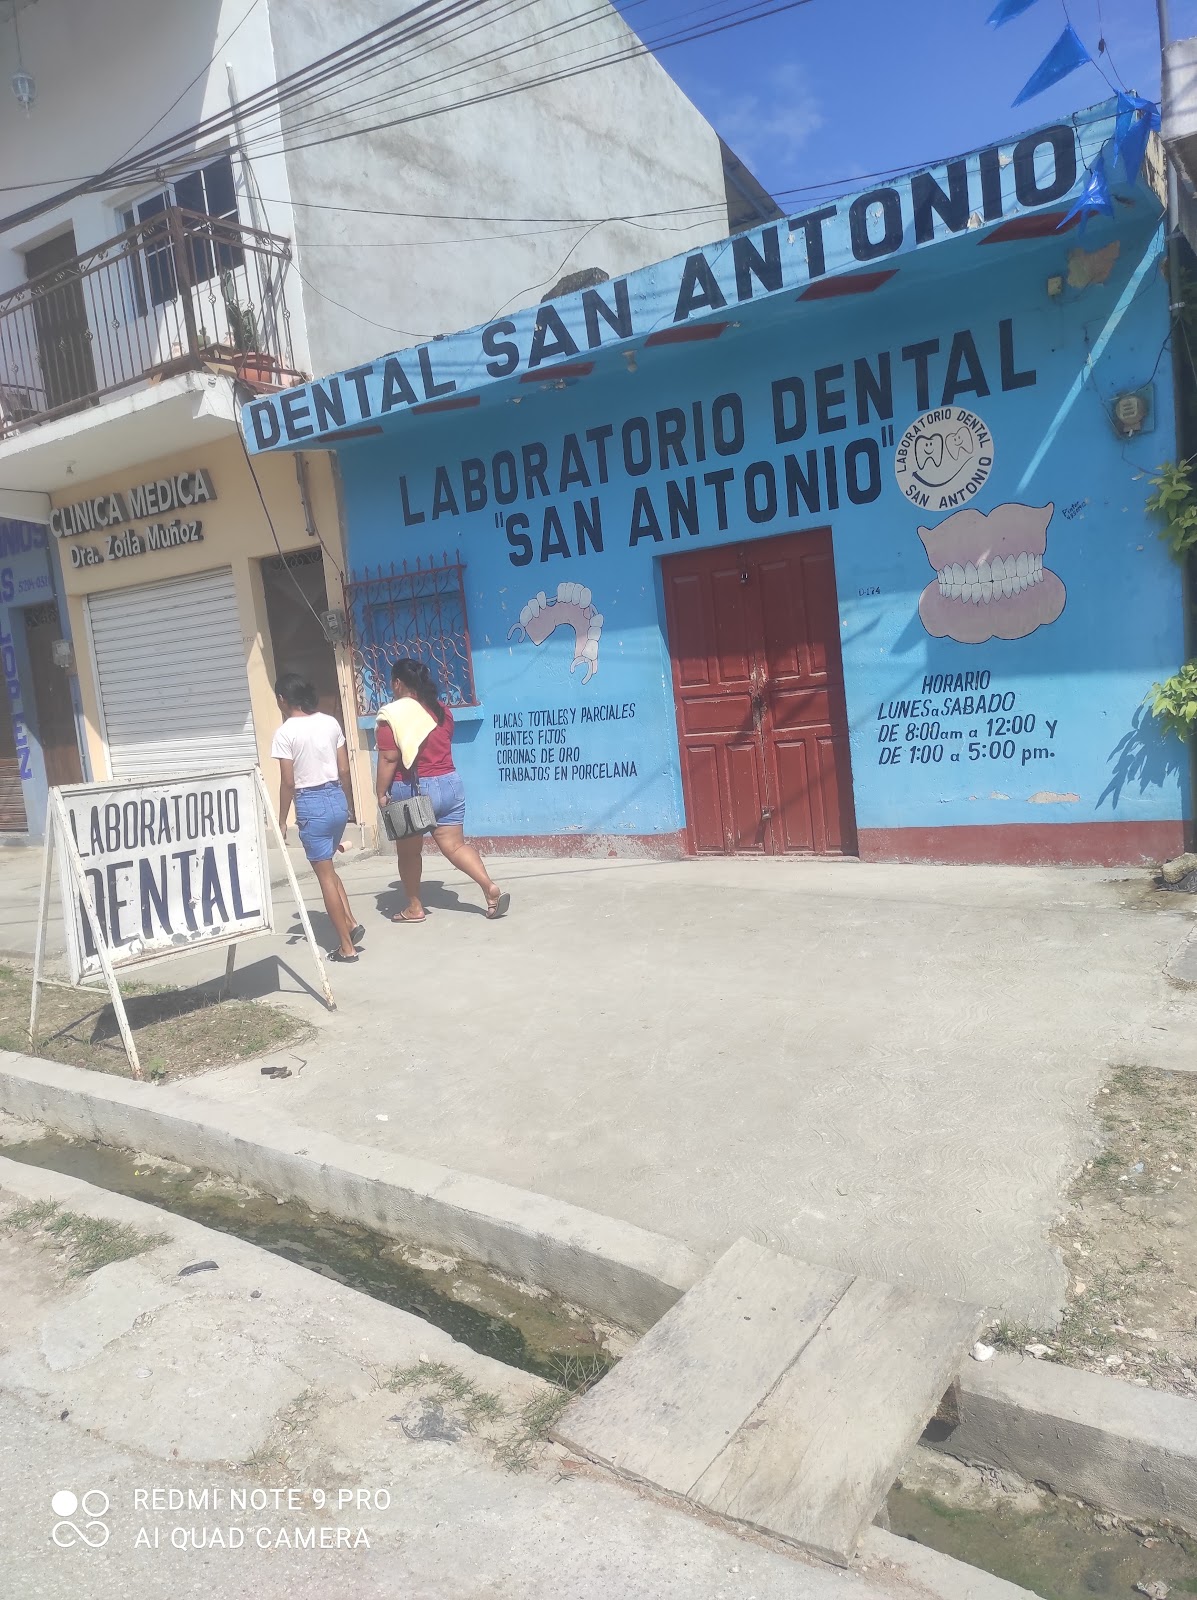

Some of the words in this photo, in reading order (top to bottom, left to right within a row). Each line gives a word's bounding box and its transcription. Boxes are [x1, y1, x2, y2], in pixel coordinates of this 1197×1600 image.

[249, 347, 456, 450] DENTAL
[482, 280, 633, 377] SAN
[673, 124, 1077, 322] ANTONIO
[400, 392, 745, 527] LABORATORIO
[771, 318, 1037, 444] DENTAL
[897, 408, 952, 474] LABORATORIO
[956, 410, 990, 448] DENTAL
[906, 484, 930, 507] SAN
[939, 456, 992, 509] ANTONIO
[50, 492, 126, 538] CLINICA
[128, 469, 213, 520] MEDICA
[70, 545, 101, 569] Dra.
[105, 529, 143, 560] Zoila
[921, 670, 991, 694] HORARIO
[493, 711, 523, 729] PLACAS
[580, 703, 636, 723] PARCIALES
[877, 699, 931, 721] LUNES
[941, 691, 1016, 716] SABADO
[495, 730, 534, 746] PUENTES
[538, 729, 566, 745] FIJOS
[877, 724, 899, 743] DE
[969, 730, 978, 738] a
[986, 714, 1036, 737] 12:00
[496, 749, 536, 765] CORONAS
[541, 748, 555, 764] DE
[558, 747, 580, 763] ORO
[878, 746, 902, 765] DE
[910, 744, 944, 764] 1:00
[950, 753, 960, 762] a
[968, 740, 1016, 761] 5:00
[1021, 746, 1056, 766] pm.
[499, 766, 551, 782] TRABAJOS
[554, 766, 568, 781] EN
[571, 761, 638, 780] PORCELANA
[69, 788, 240, 858] LABORATORIO
